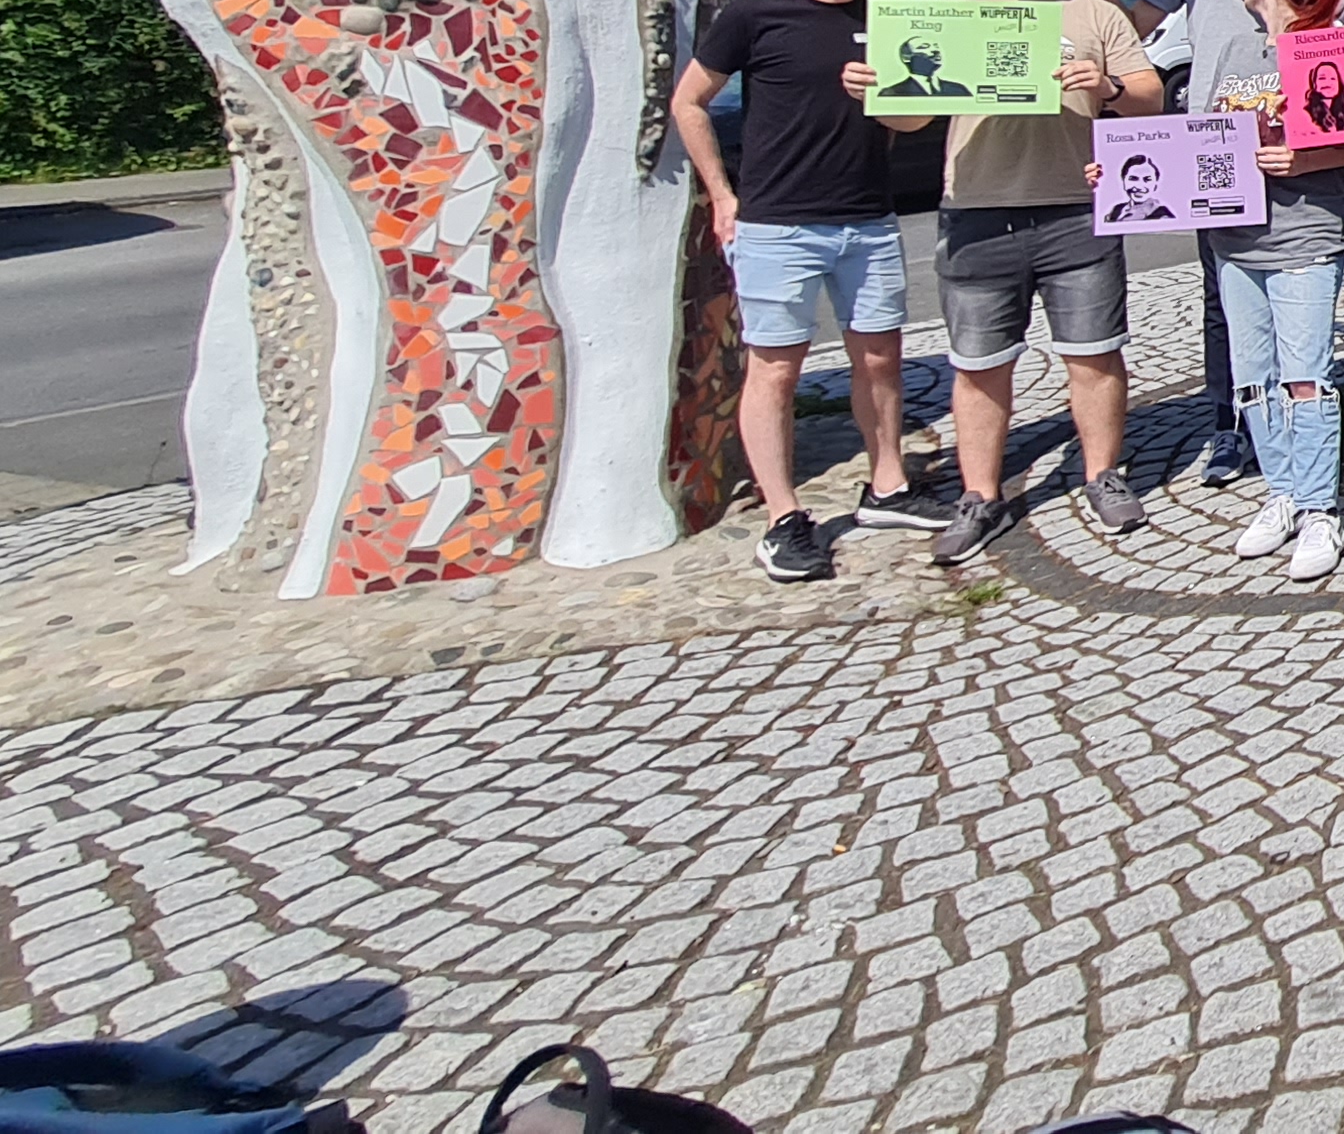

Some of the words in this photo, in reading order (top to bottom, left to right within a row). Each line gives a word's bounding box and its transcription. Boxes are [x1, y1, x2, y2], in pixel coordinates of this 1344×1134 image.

[878, 6, 926, 17] Martin
[929, 6, 975, 18] Luther
[910, 20, 942, 32] King
[979, 6, 1037, 33] WUPPERTAL
[1106, 133, 1135, 144] Rosa
[1137, 131, 1171, 142] Parks
[1186, 118, 1237, 144] WUPPERTAL
